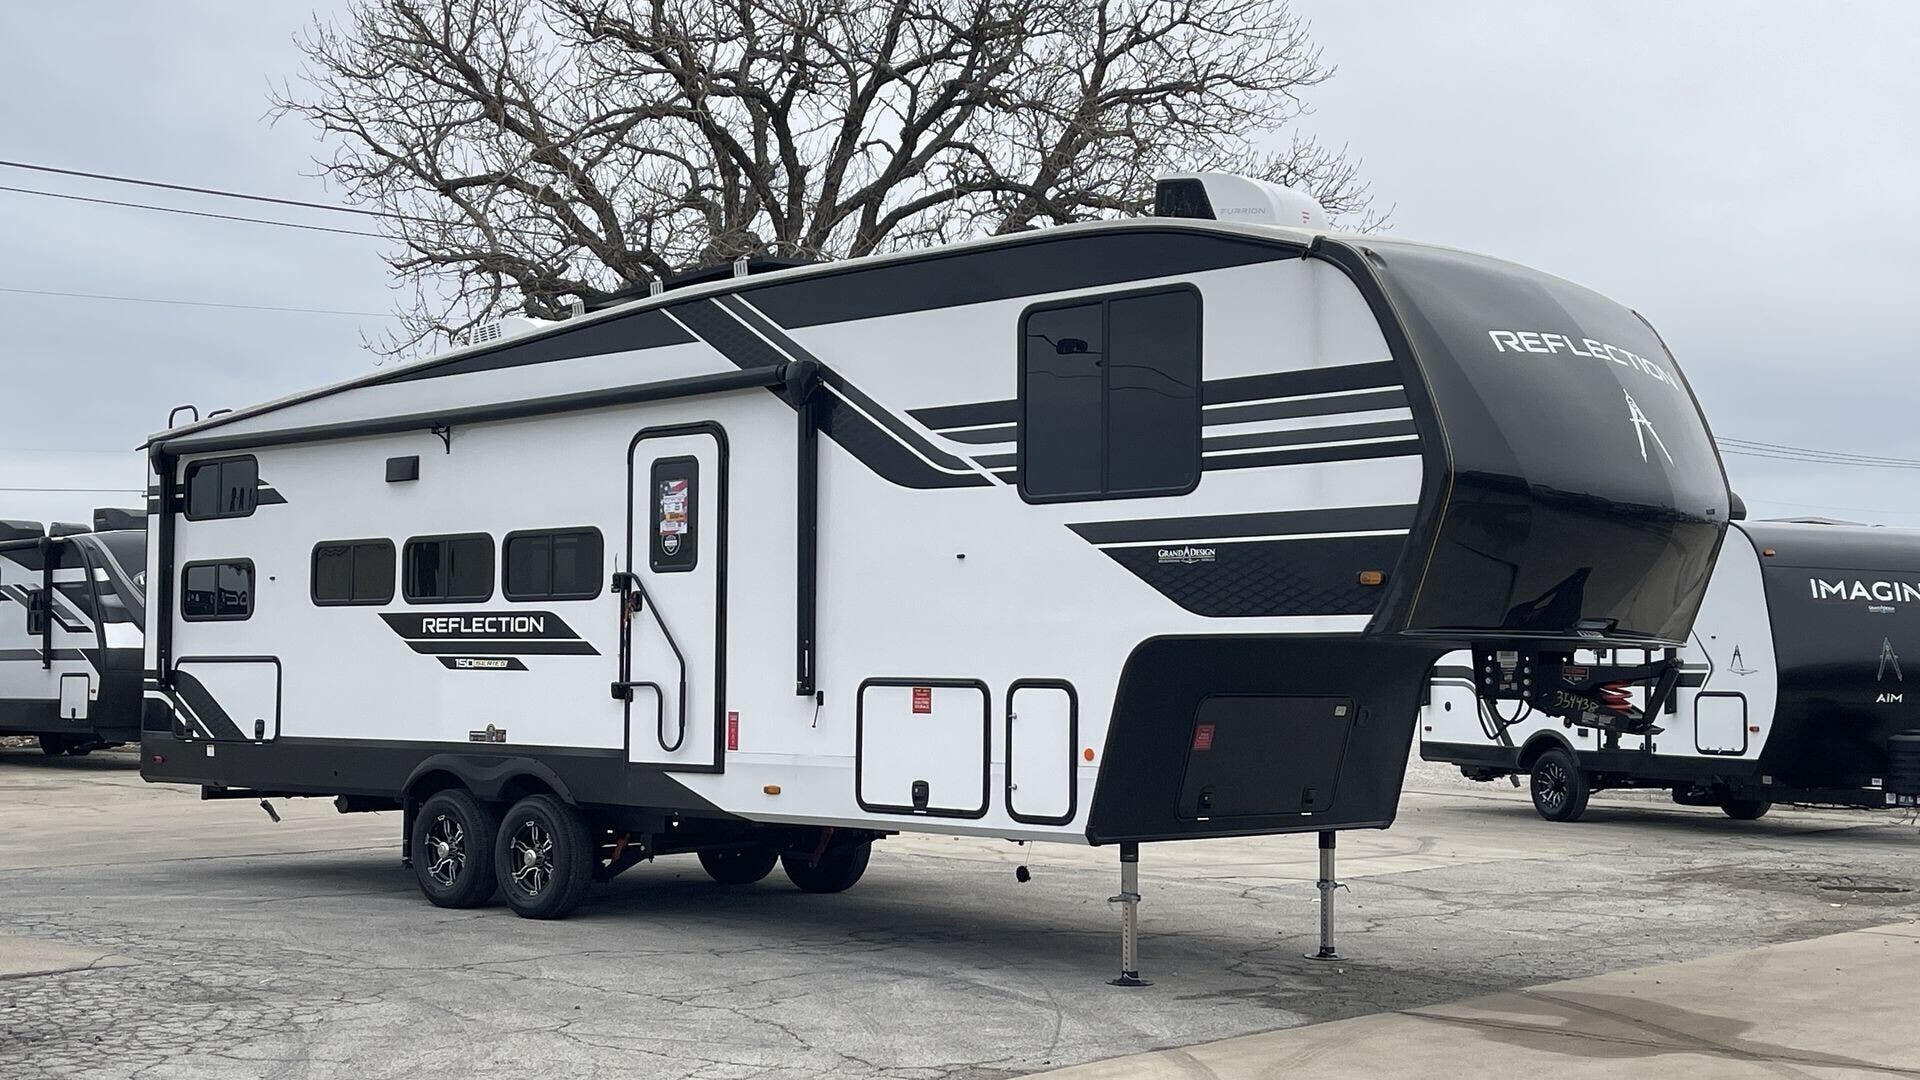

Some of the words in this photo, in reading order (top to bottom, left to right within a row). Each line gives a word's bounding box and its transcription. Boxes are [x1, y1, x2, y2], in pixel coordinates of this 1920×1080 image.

[1488, 329, 1680, 391] REFLECTION
[1157, 548, 1184, 557] GRAND
[1190, 547, 1216, 556] DESIGN
[422, 616, 544, 633] REFLECTION
[1875, 693, 1903, 703] AIM
